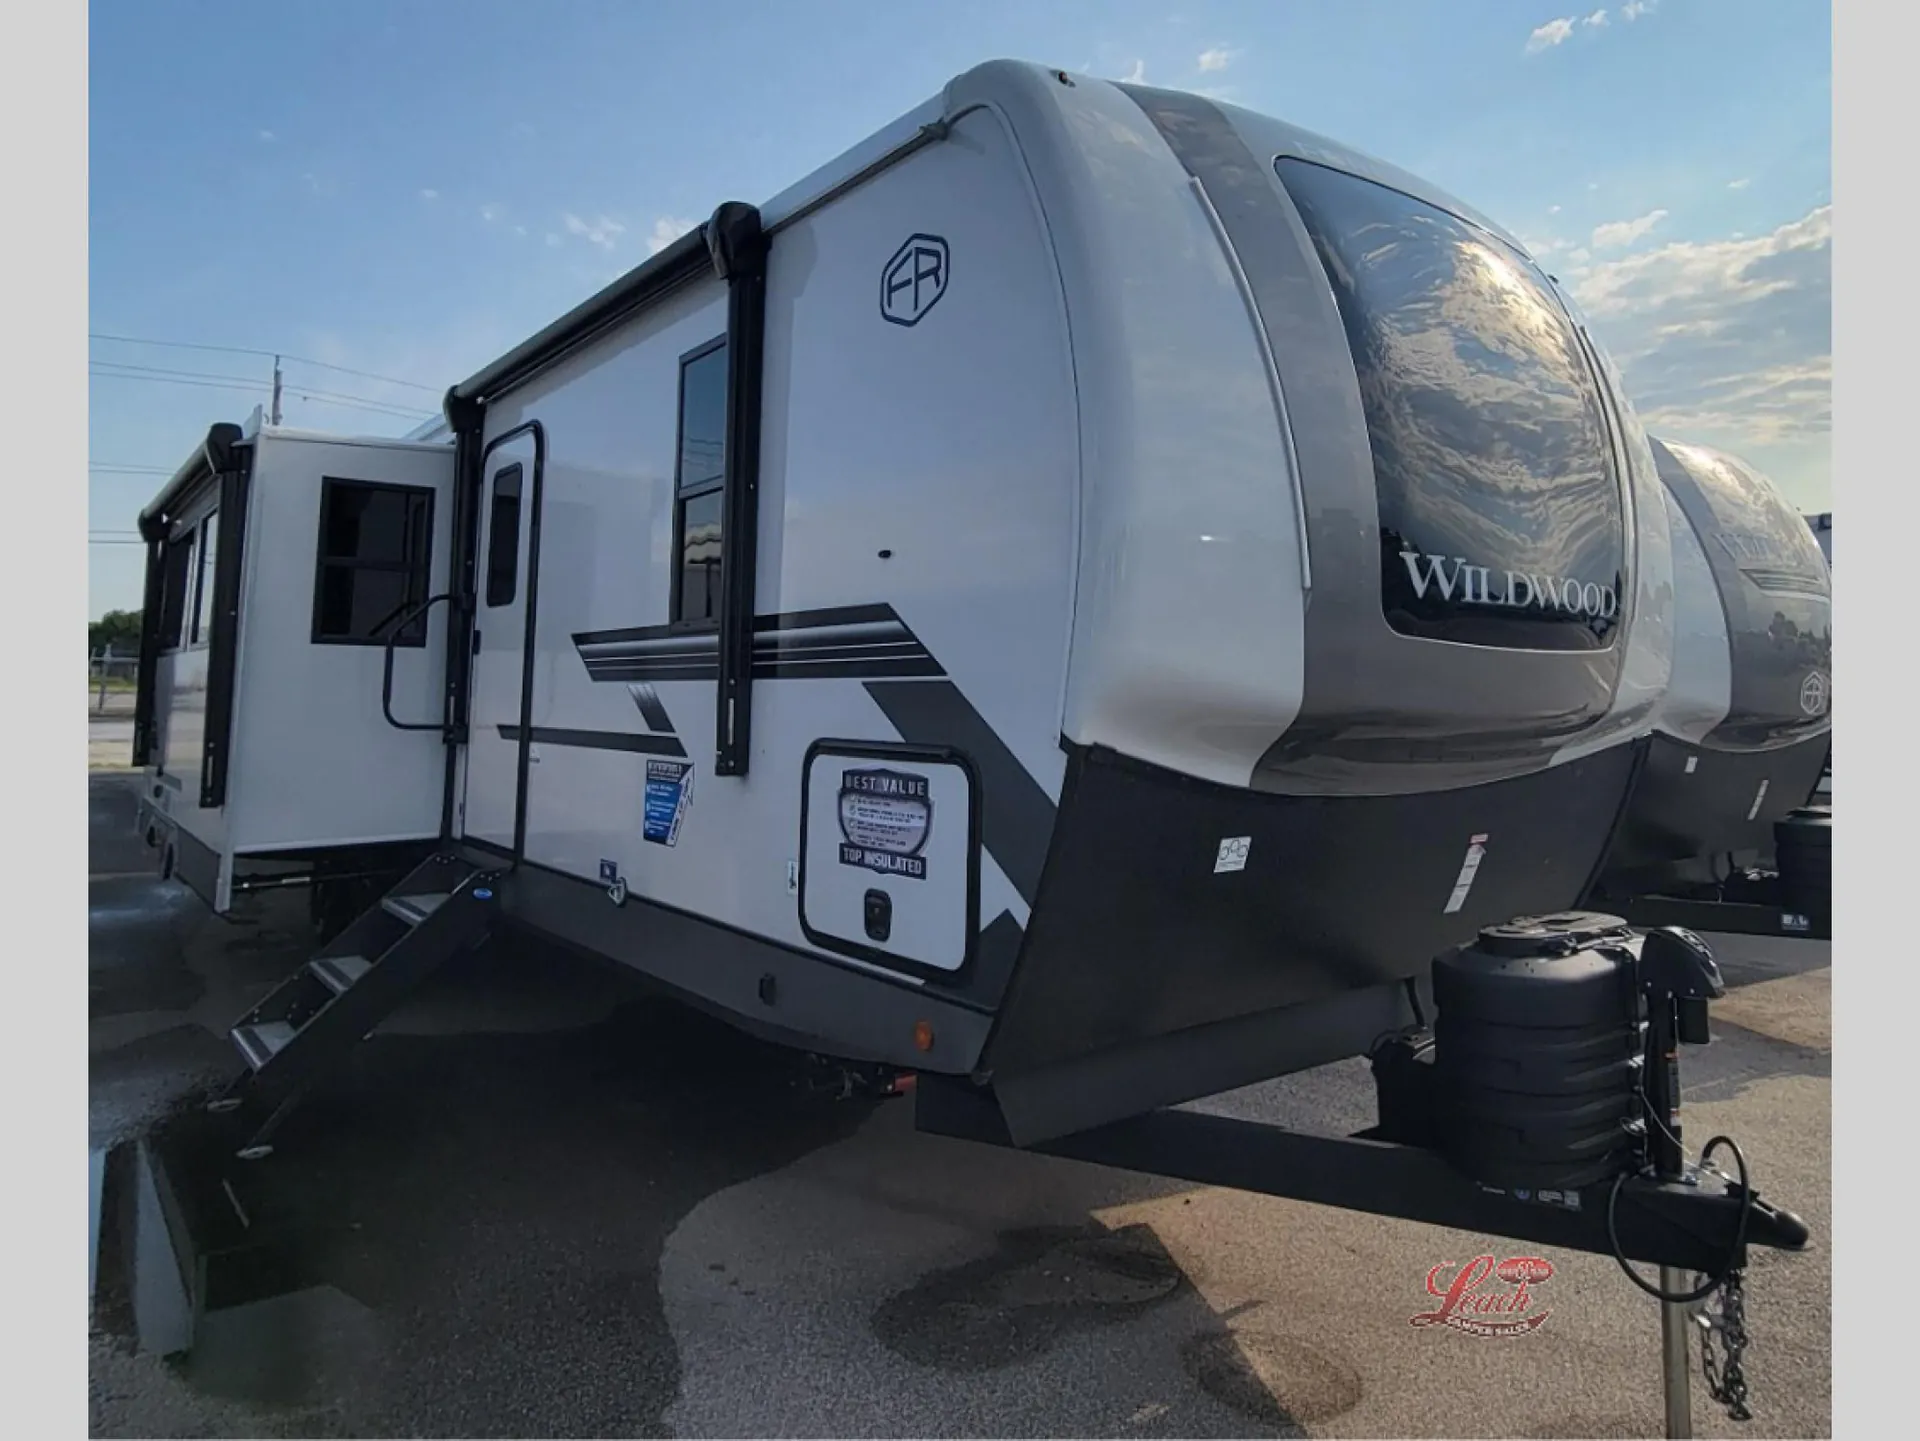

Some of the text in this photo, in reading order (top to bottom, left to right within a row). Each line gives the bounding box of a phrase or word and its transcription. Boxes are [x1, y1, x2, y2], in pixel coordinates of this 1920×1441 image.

[885, 243, 943, 313] FR
[1399, 551, 1616, 618] WILDWOOD
[845, 774, 925, 796] BEST VALUE
[843, 847, 922, 874] TOP INSULATED
